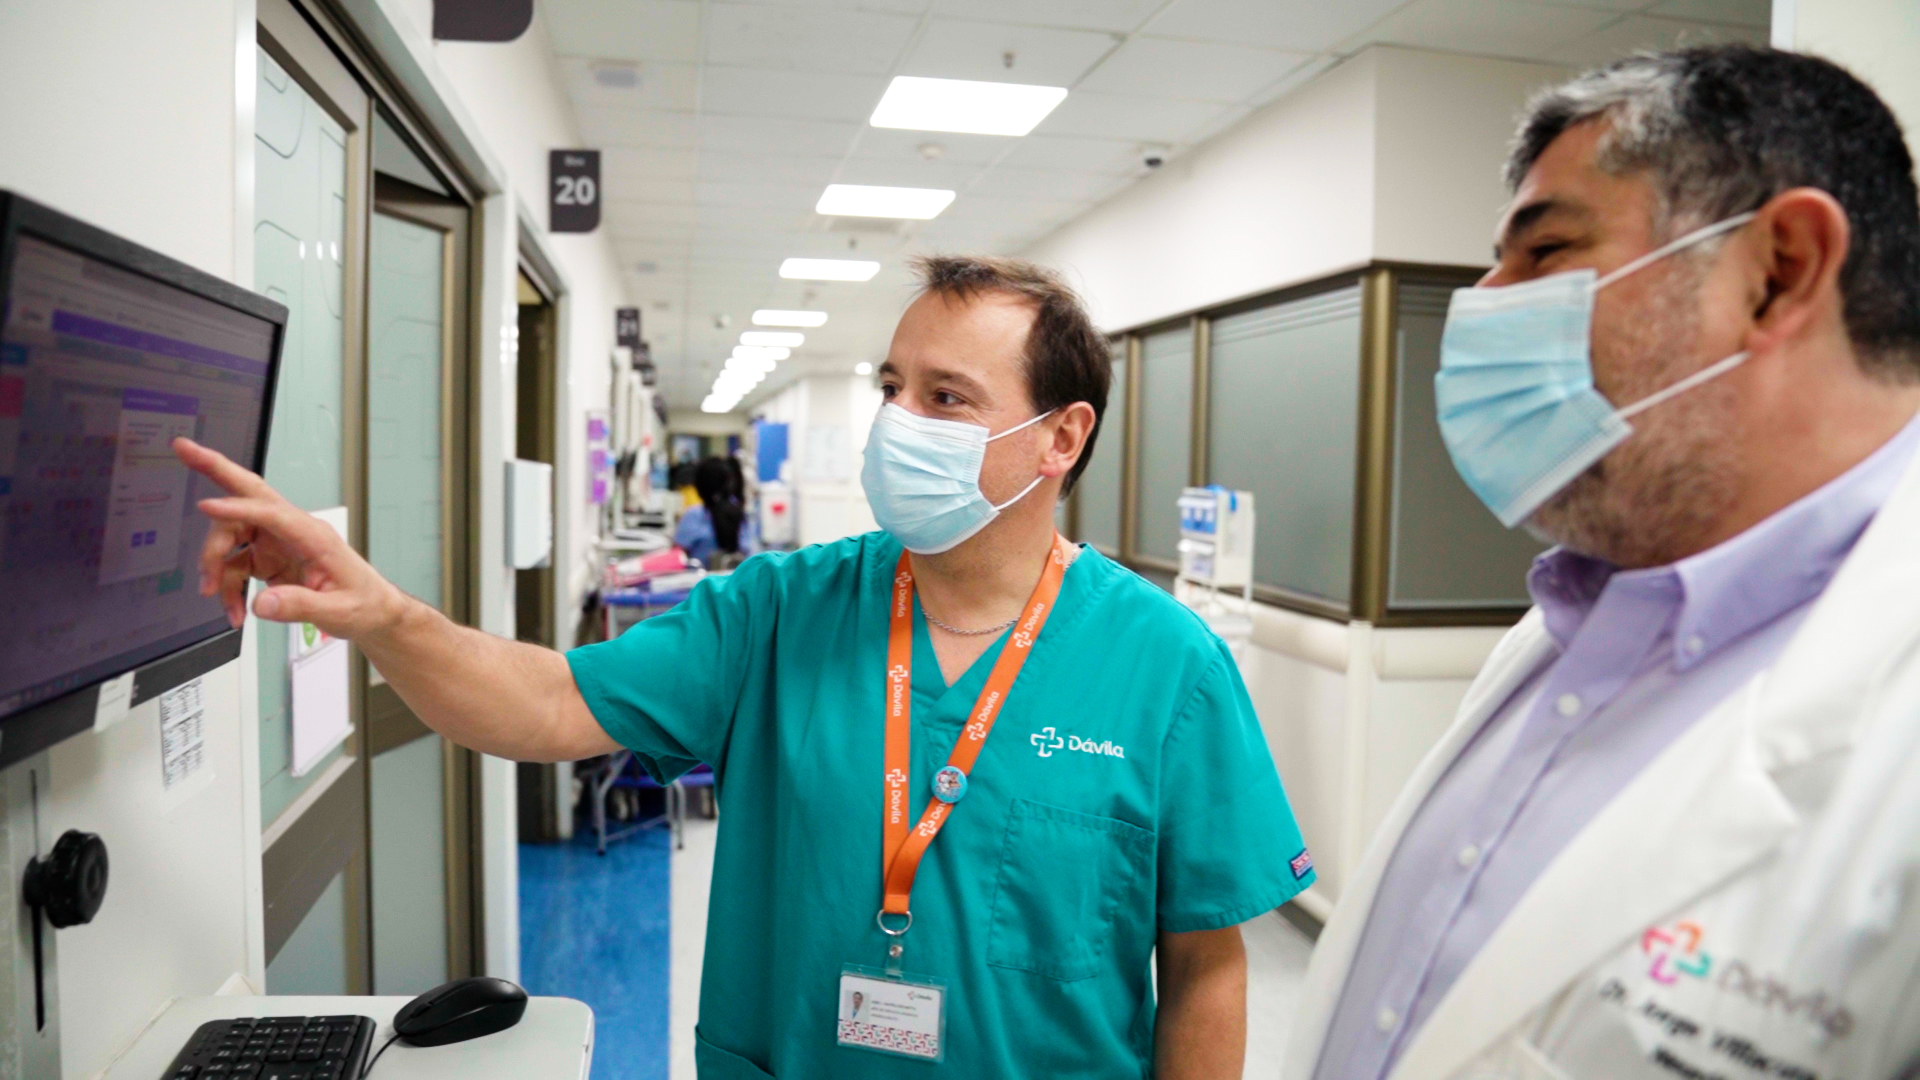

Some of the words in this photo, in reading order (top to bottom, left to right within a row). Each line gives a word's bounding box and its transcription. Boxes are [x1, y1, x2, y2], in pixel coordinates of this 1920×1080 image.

[555, 175, 596, 206] 20
[892, 684, 905, 718] Dávila
[1068, 735, 1125, 759] Dávila
[890, 789, 902, 824] Dávila
